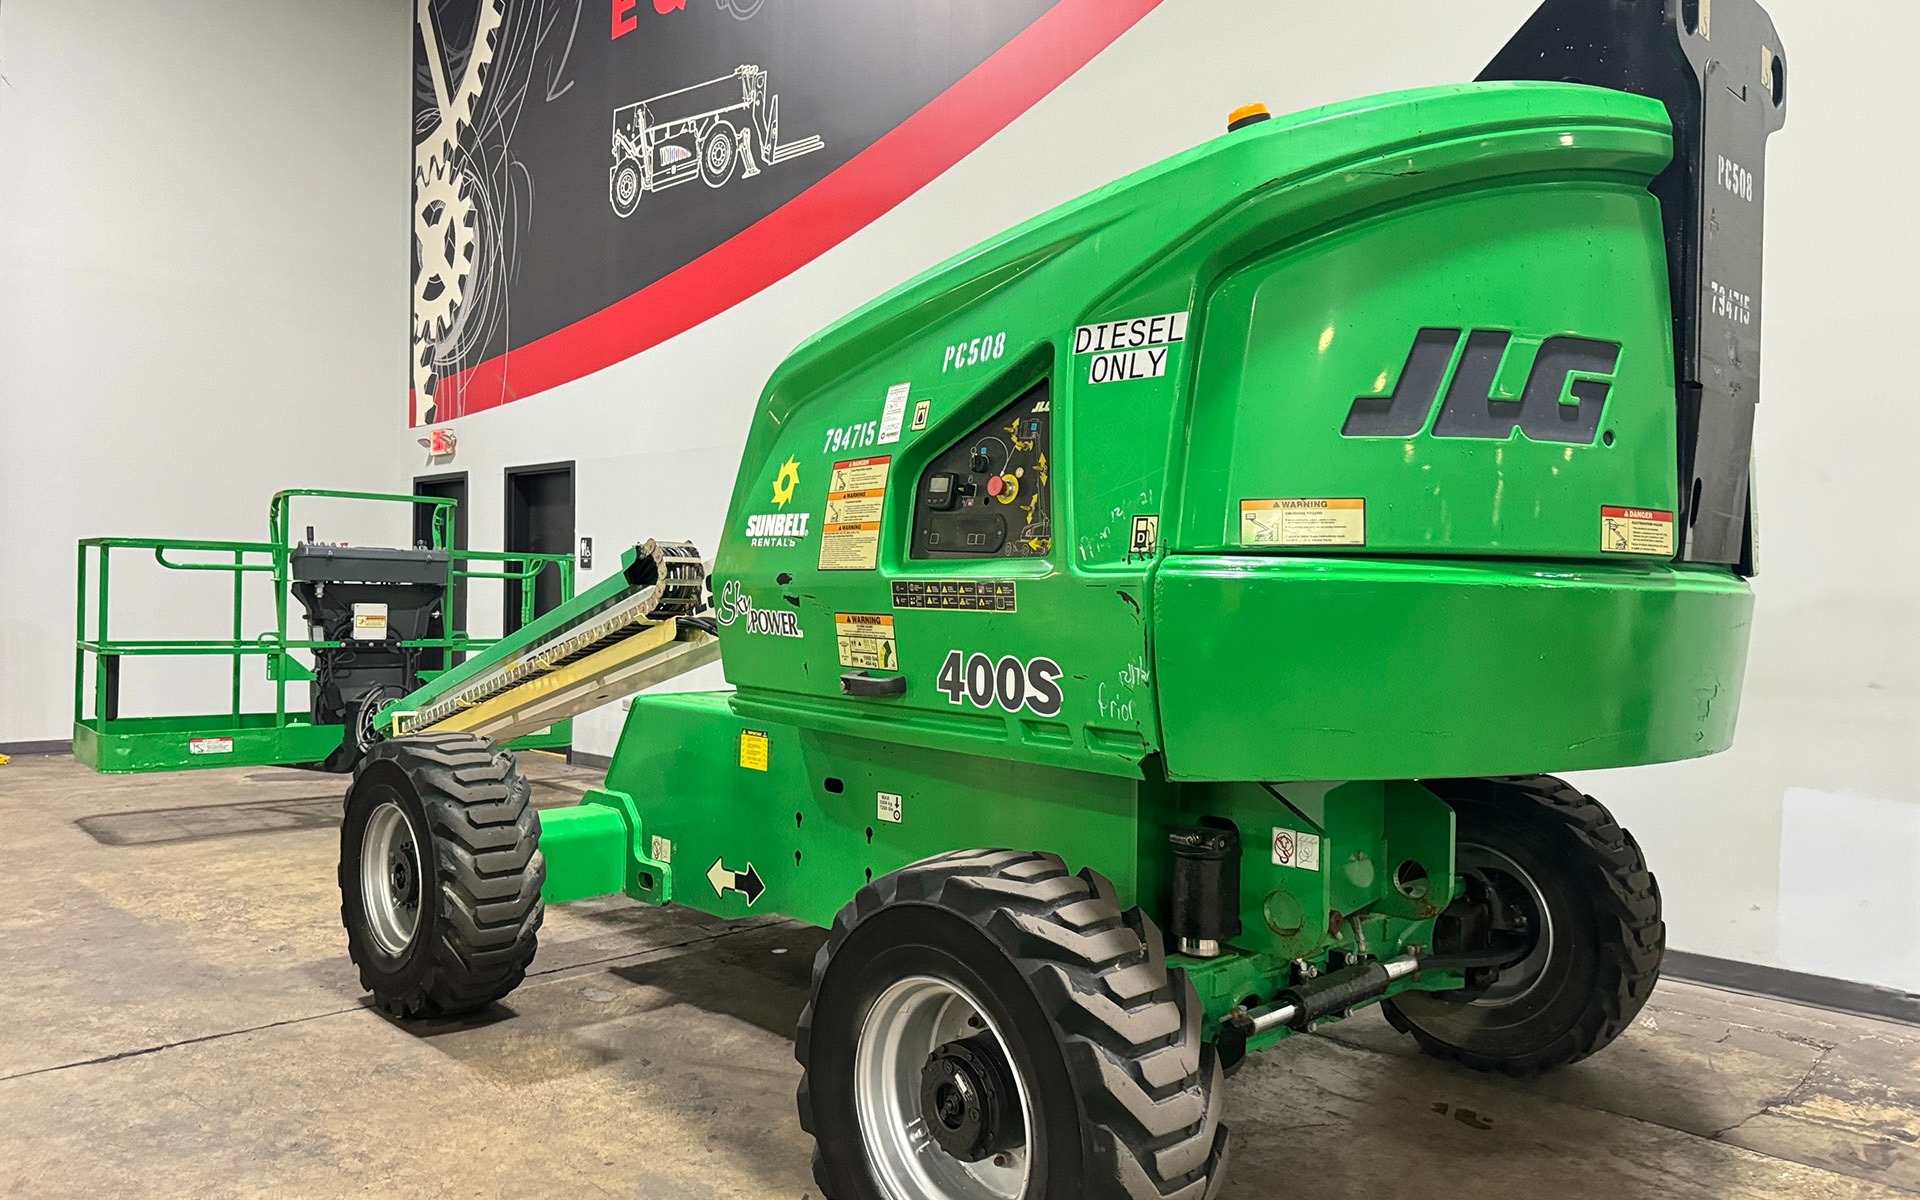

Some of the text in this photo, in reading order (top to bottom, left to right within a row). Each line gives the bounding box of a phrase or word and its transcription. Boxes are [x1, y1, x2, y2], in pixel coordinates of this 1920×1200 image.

[1718, 154, 1752, 202] PC508
[1711, 281, 1750, 325] 794715
[1075, 315, 1184, 354] DIESEL
[942, 331, 1006, 373] PC508
[1092, 348, 1167, 383] ONLY
[823, 420, 877, 454] 794715
[1281, 500, 1328, 508] WARNING
[1629, 510, 1653, 519] DANGER
[751, 538, 796, 547] RENTALS
[750, 609, 800, 637] POWER
[851, 616, 881, 625] WARNING
[937, 649, 1064, 718] 400S
